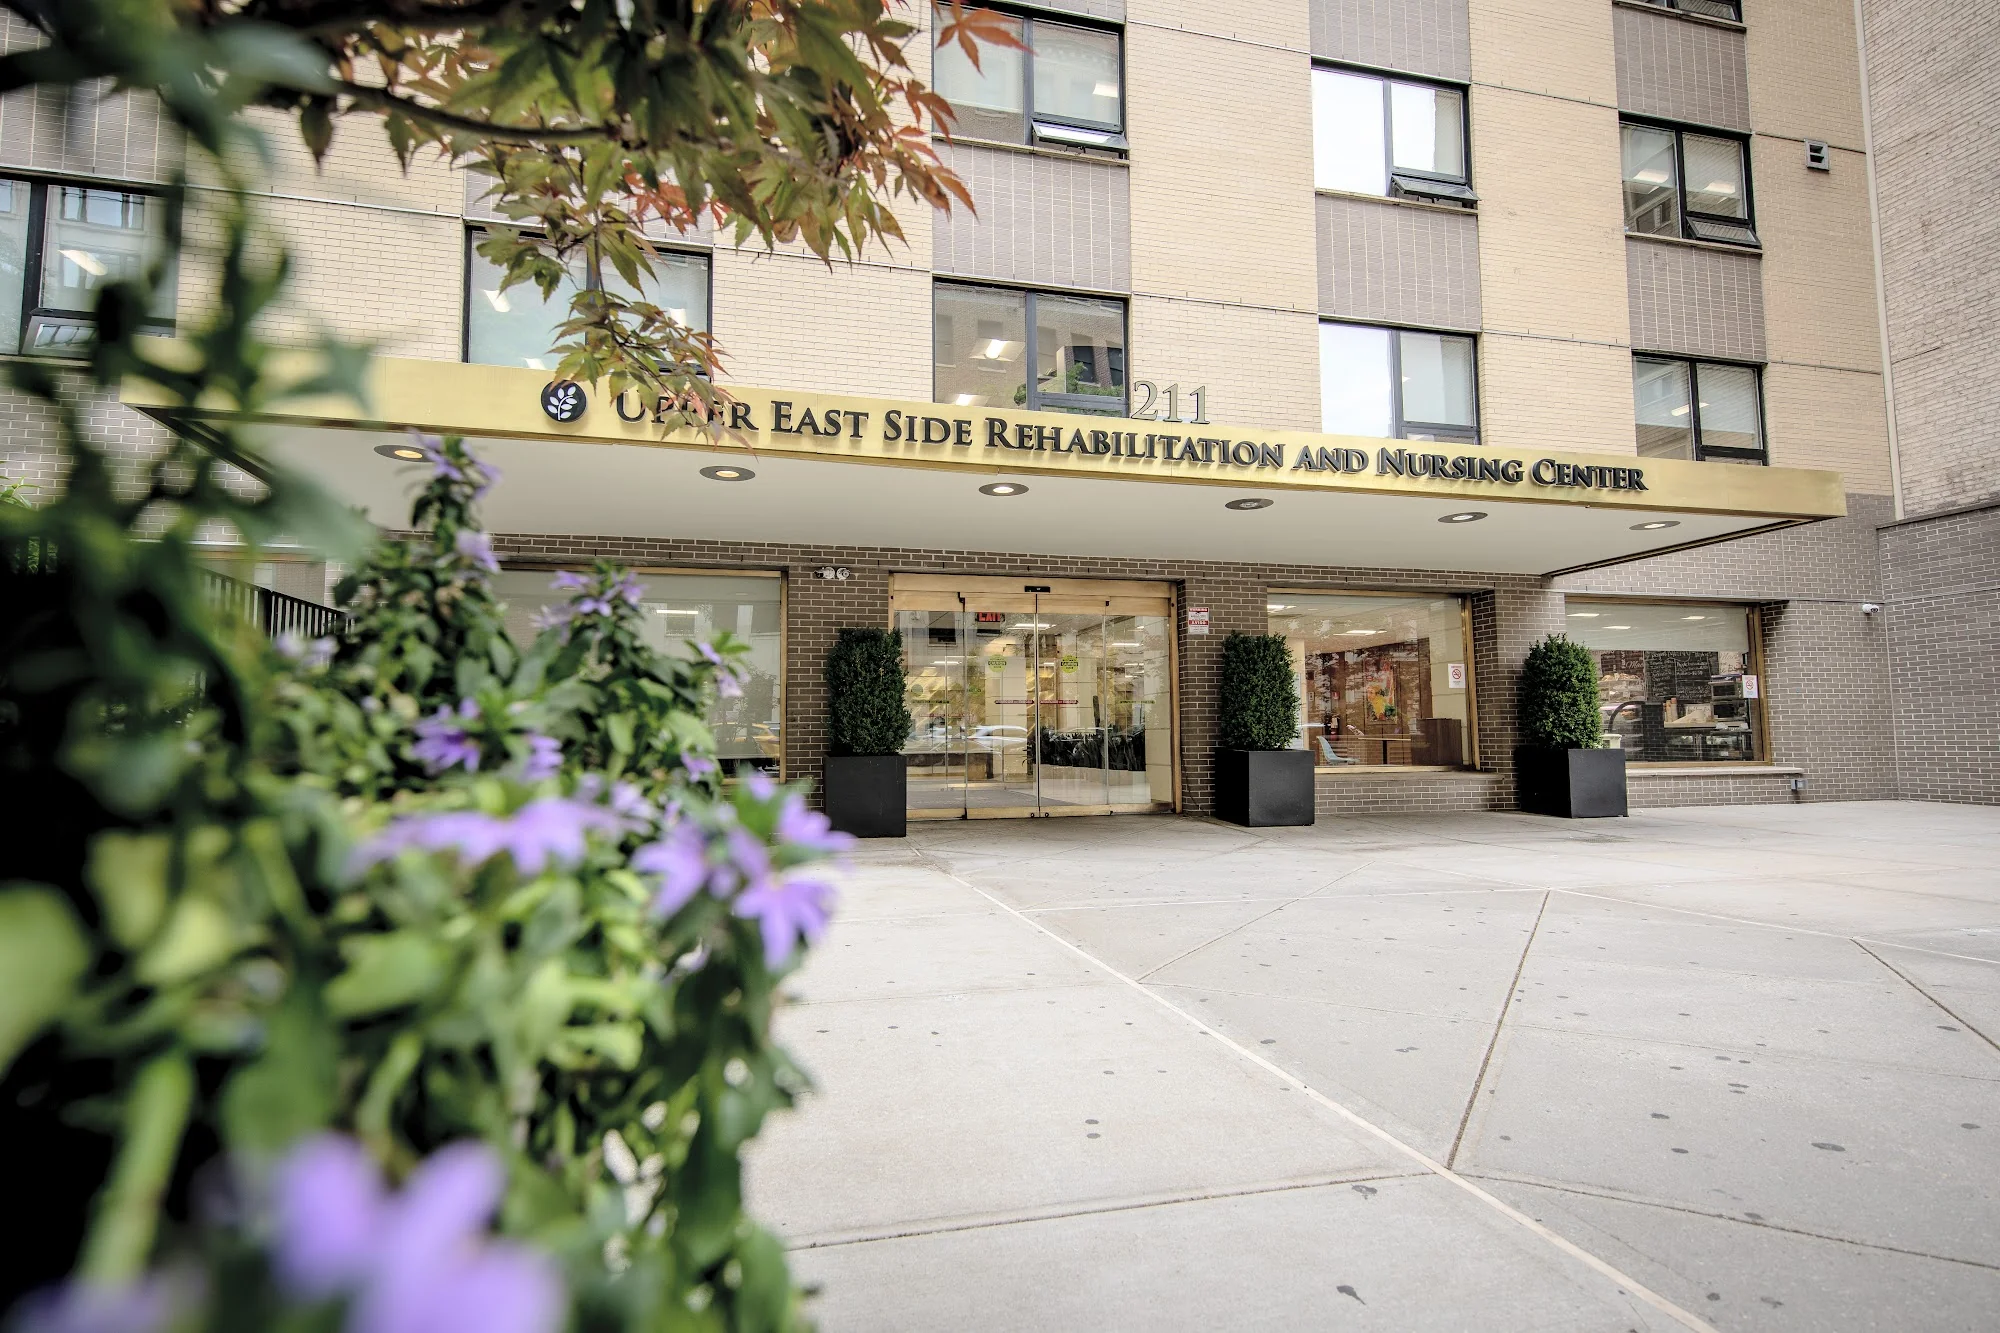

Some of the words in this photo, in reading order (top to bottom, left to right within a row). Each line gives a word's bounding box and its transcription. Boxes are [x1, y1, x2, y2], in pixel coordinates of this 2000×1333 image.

[1131, 380, 1210, 425] 211
[770, 400, 868, 439] EAST
[883, 409, 973, 447] SIDE
[985, 417, 1285, 468] REHABILITATION
[1294, 445, 1369, 473] AND
[1377, 446, 1524, 484] NURSING
[1532, 457, 1649, 492] CENTER
